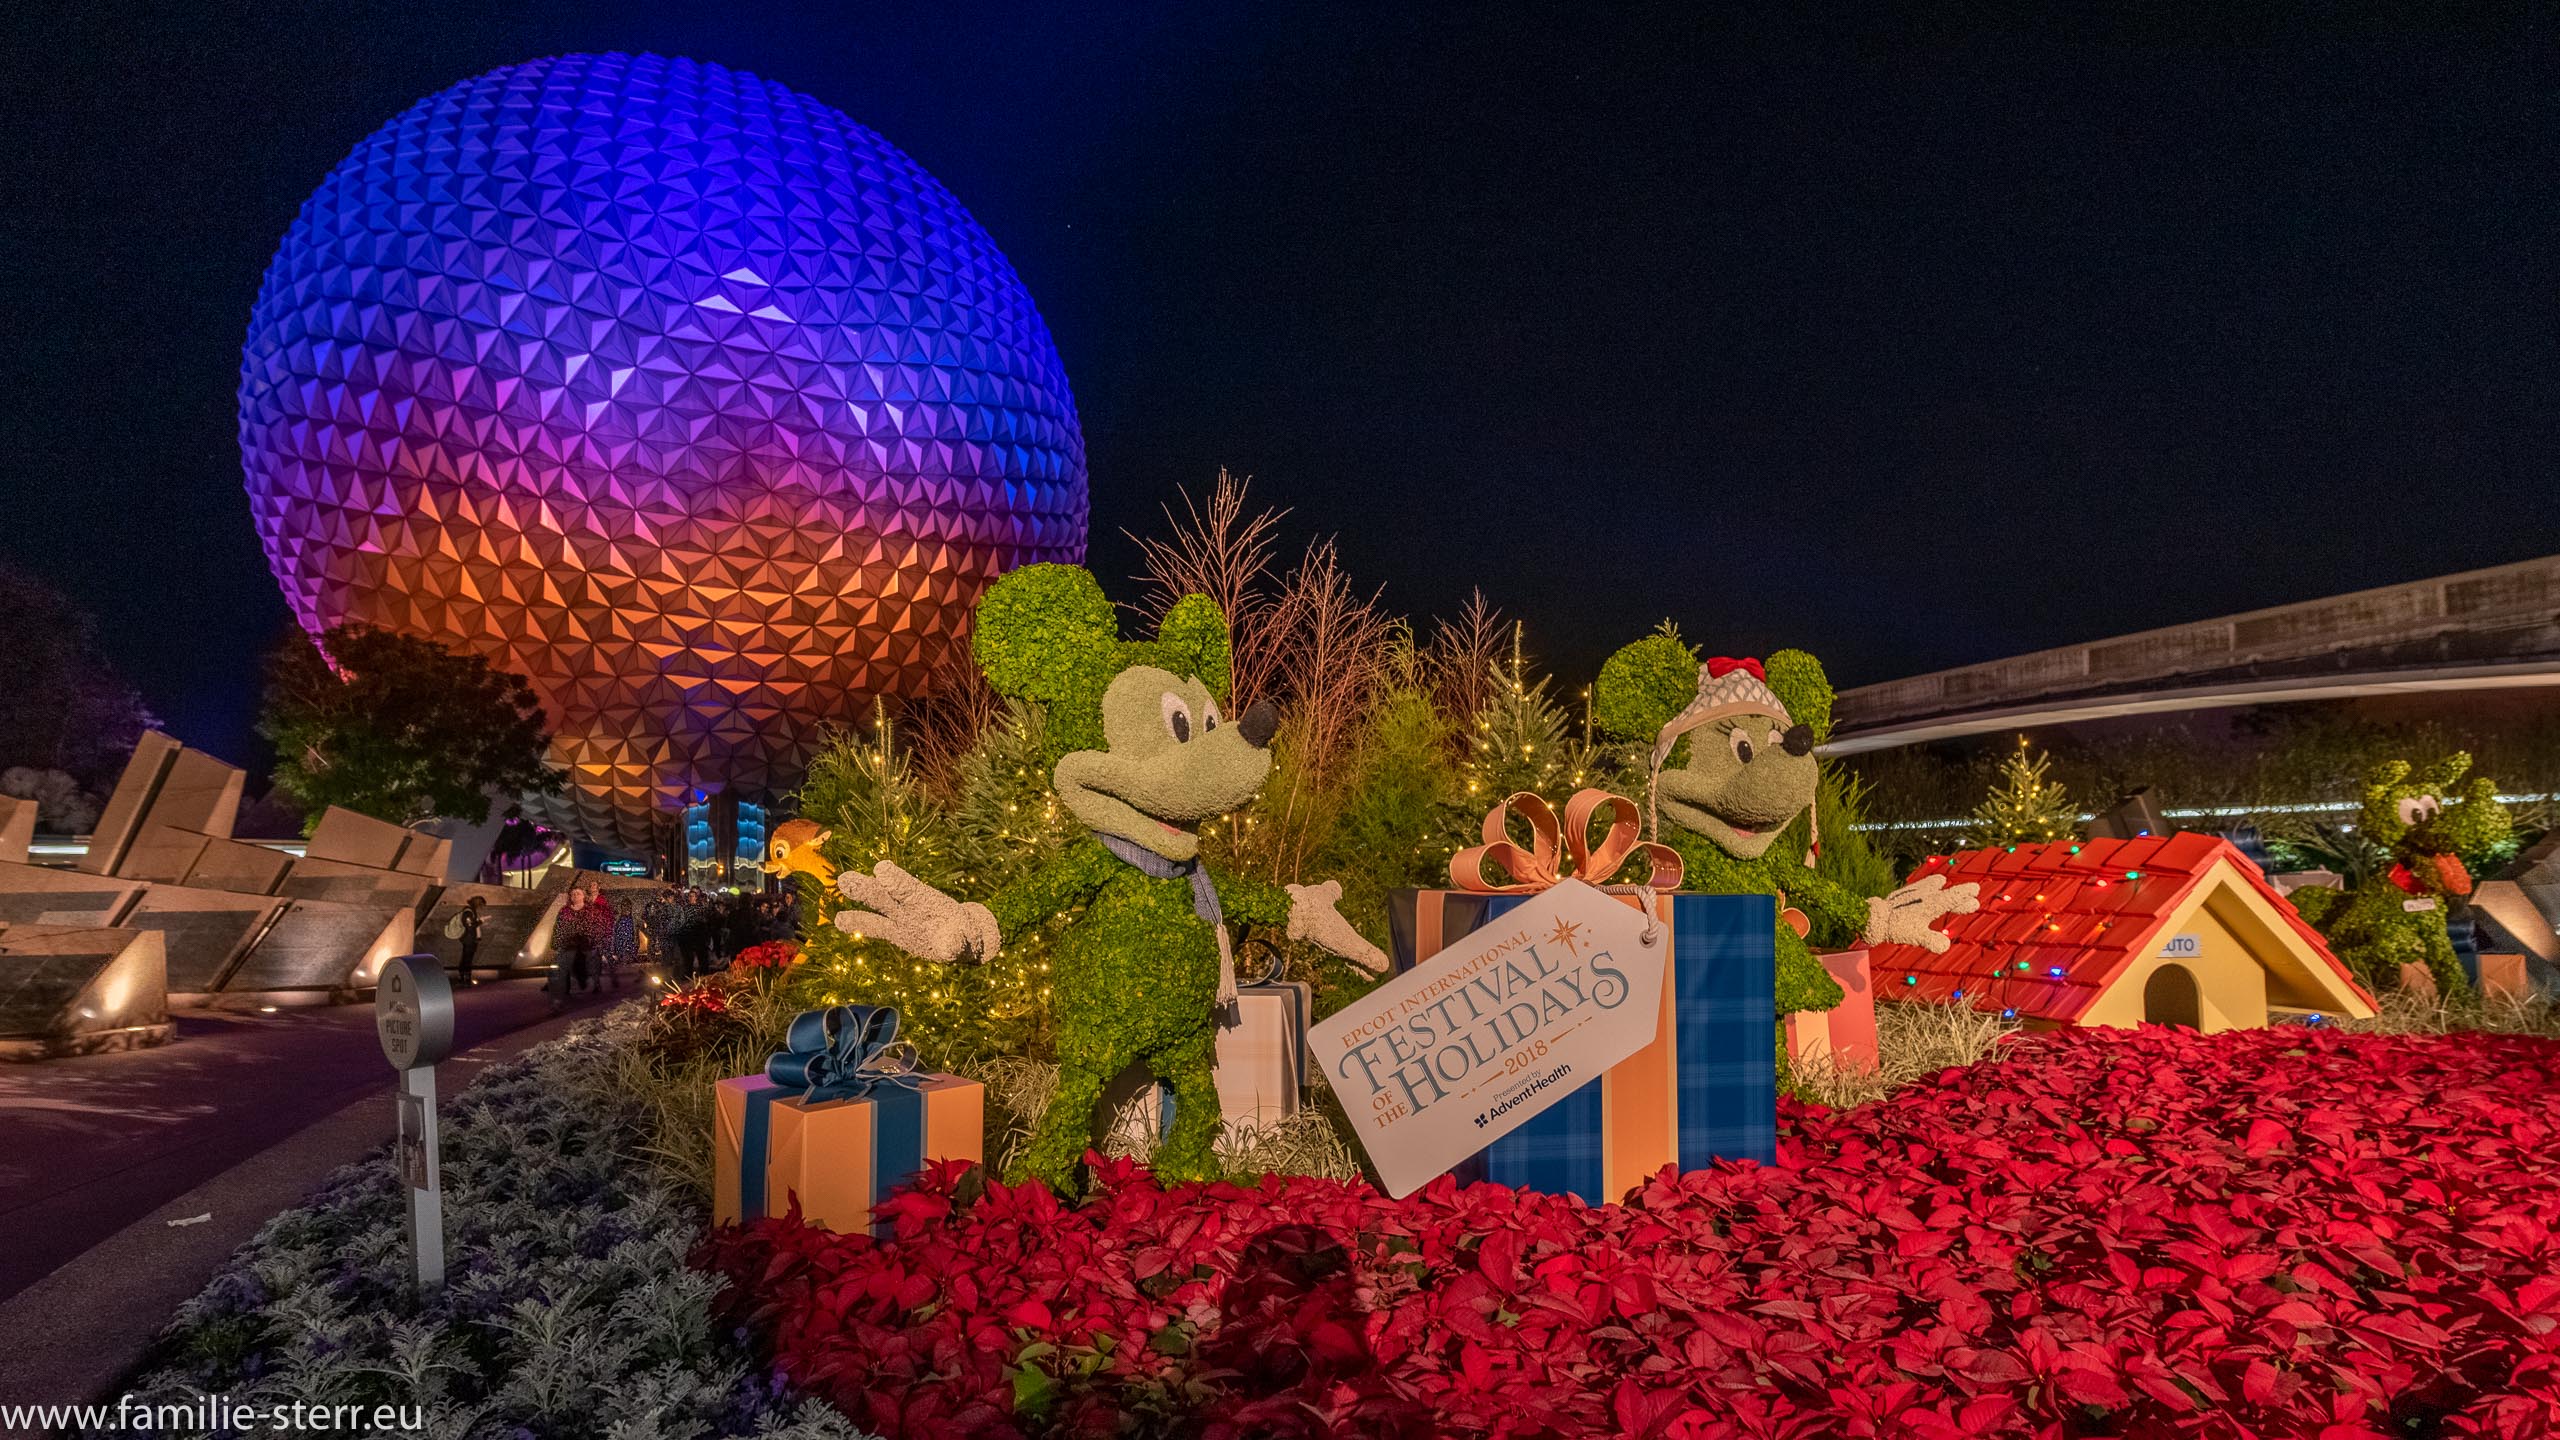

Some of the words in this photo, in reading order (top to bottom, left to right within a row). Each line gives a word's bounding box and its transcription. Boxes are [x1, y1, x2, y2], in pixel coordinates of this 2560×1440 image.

[2162, 938, 2194, 951] UTO
[1341, 1008, 1395, 1048] EPCOT
[1400, 930, 1532, 1014] INTERNATIONAL
[386, 1019, 412, 1036] PICTURE
[1338, 944, 1560, 1095] FESTIVAL
[1388, 950, 1630, 1116] HOLIDAYS
[391, 1038, 408, 1054] SPOT
[1504, 1039, 1548, 1075] 2018
[1372, 1090, 1394, 1111] OF
[1490, 1063, 1572, 1120] AdventHealth
[1493, 1075, 1531, 1102] Presented
[1531, 1069, 1542, 1080] by
[1373, 1101, 1409, 1129] THE
